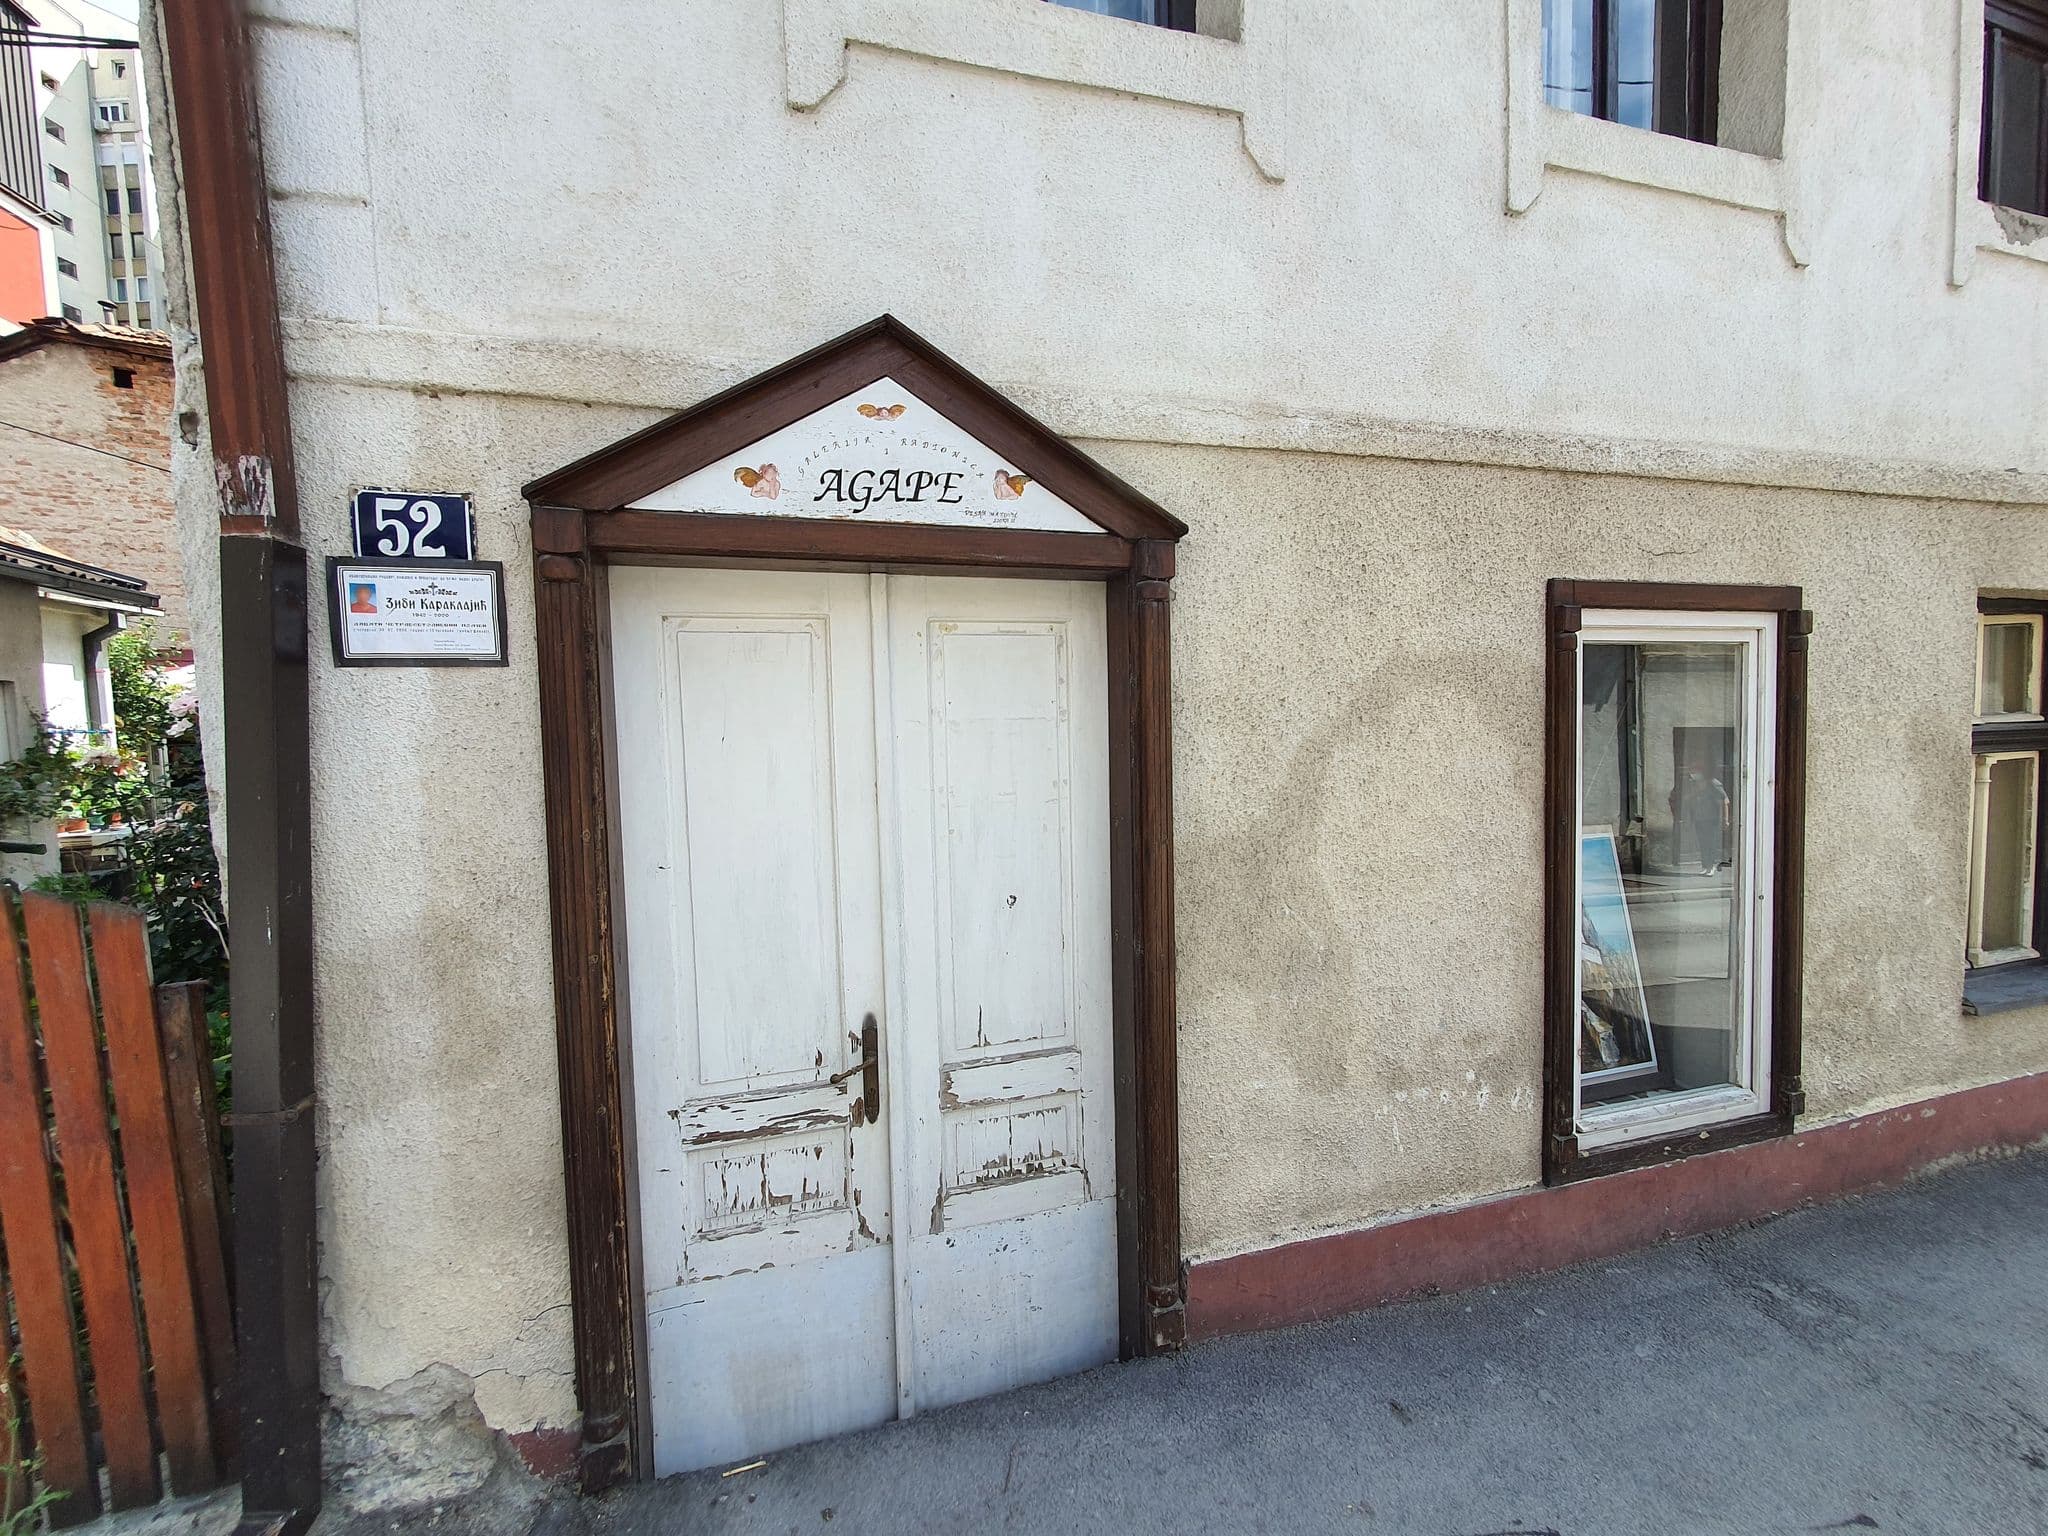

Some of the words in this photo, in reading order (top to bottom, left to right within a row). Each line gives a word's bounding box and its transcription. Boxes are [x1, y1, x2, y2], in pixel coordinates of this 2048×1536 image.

[813, 468, 964, 514] AGAPE
[375, 497, 446, 557] 52
[420, 598, 487, 612] Караклајић
